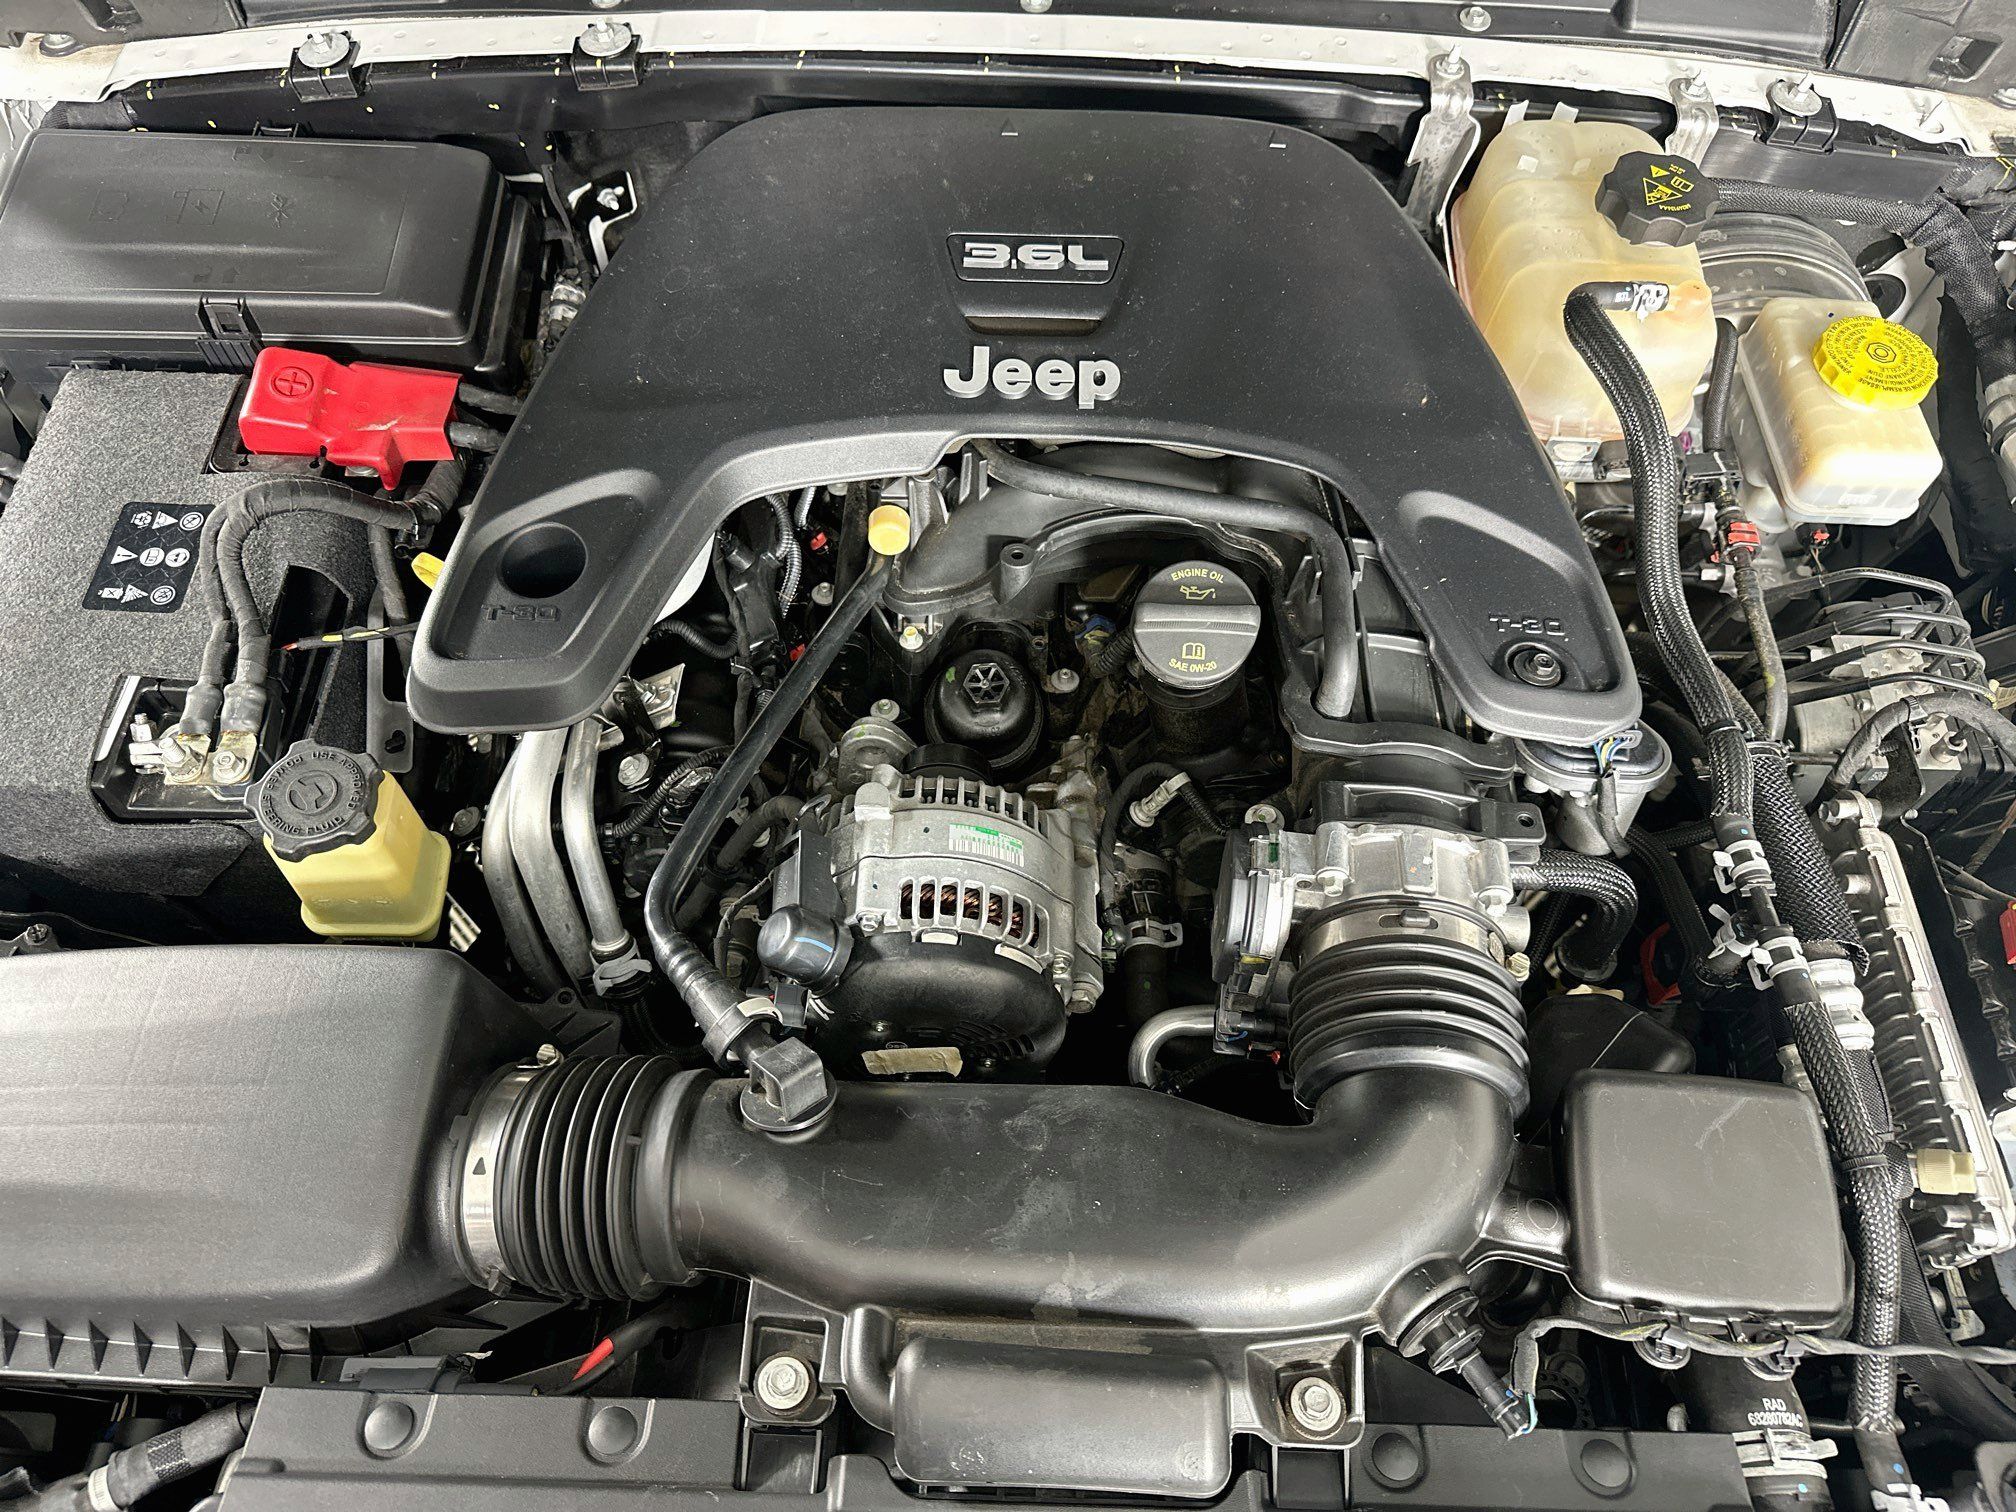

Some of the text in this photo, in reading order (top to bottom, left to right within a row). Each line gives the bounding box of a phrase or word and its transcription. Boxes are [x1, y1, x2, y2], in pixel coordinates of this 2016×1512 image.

[963, 242, 1108, 270] 3.6L
[943, 346, 1121, 409] Jeep
[1171, 568, 1224, 583] ENGINE OIL
[1488, 614, 1566, 636] T-30
[1168, 658, 1218, 673] SAE 0W-20
[311, 750, 362, 809] USE APPROVED
[262, 756, 346, 834] POWER STEERING FLUID
[1762, 1398, 1787, 1411] RAD
